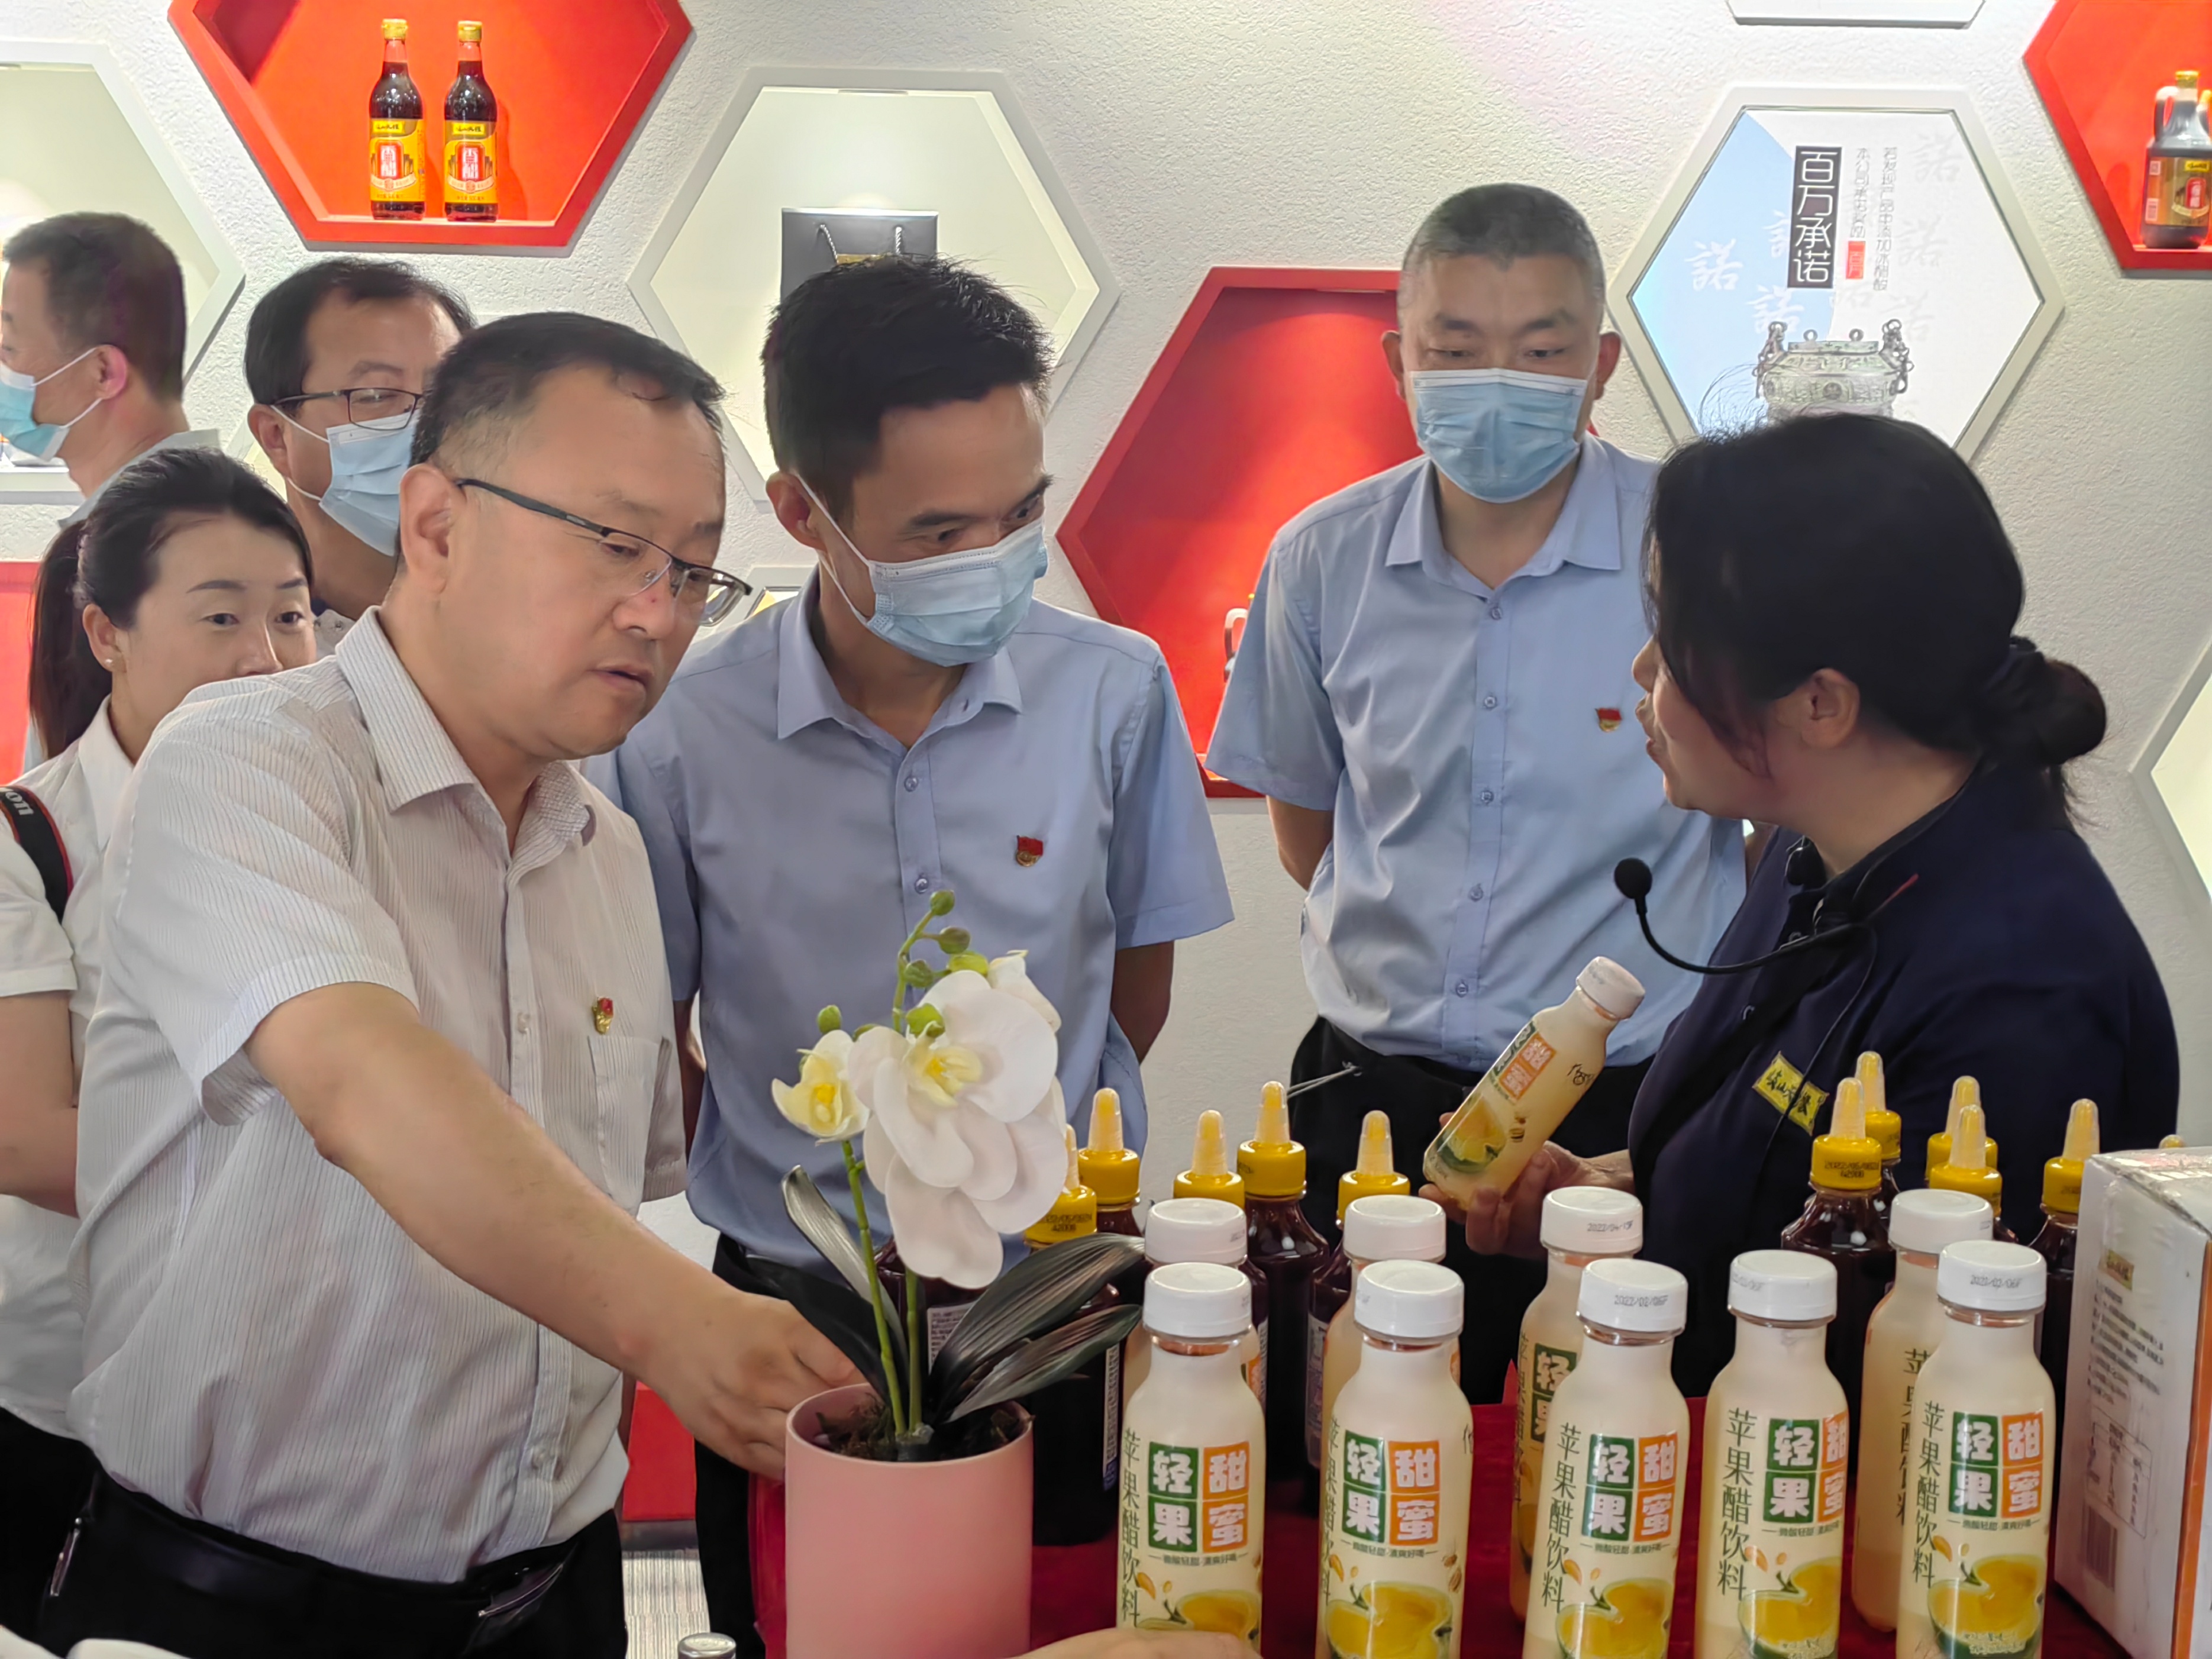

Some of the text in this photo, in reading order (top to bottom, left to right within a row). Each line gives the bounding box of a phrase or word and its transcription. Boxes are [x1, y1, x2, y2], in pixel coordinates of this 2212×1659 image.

[1794, 151, 1838, 282] 百万承诺
[0, 787, 34, 816] on
[1346, 1438, 1436, 1487] 轻甜
[1593, 1441, 1676, 1484] 轻甜
[1774, 1421, 1846, 1466] 轻甜
[1955, 1418, 2040, 1462] 轻甜
[1152, 1450, 1247, 1494] 轻甜
[1913, 1400, 1945, 1588] 苹果醋饮料
[1953, 1470, 2039, 1512] 果蜜
[1120, 1427, 1141, 1628] 苹果醋饮料
[1153, 1502, 1245, 1548] 果蜜
[1345, 1490, 1436, 1541] 果蜜
[1541, 1422, 1581, 1614] 苹果醋饮料
[1588, 1492, 1672, 1537] 果蜜
[1717, 1408, 1758, 1601] 苹果醋饮料
